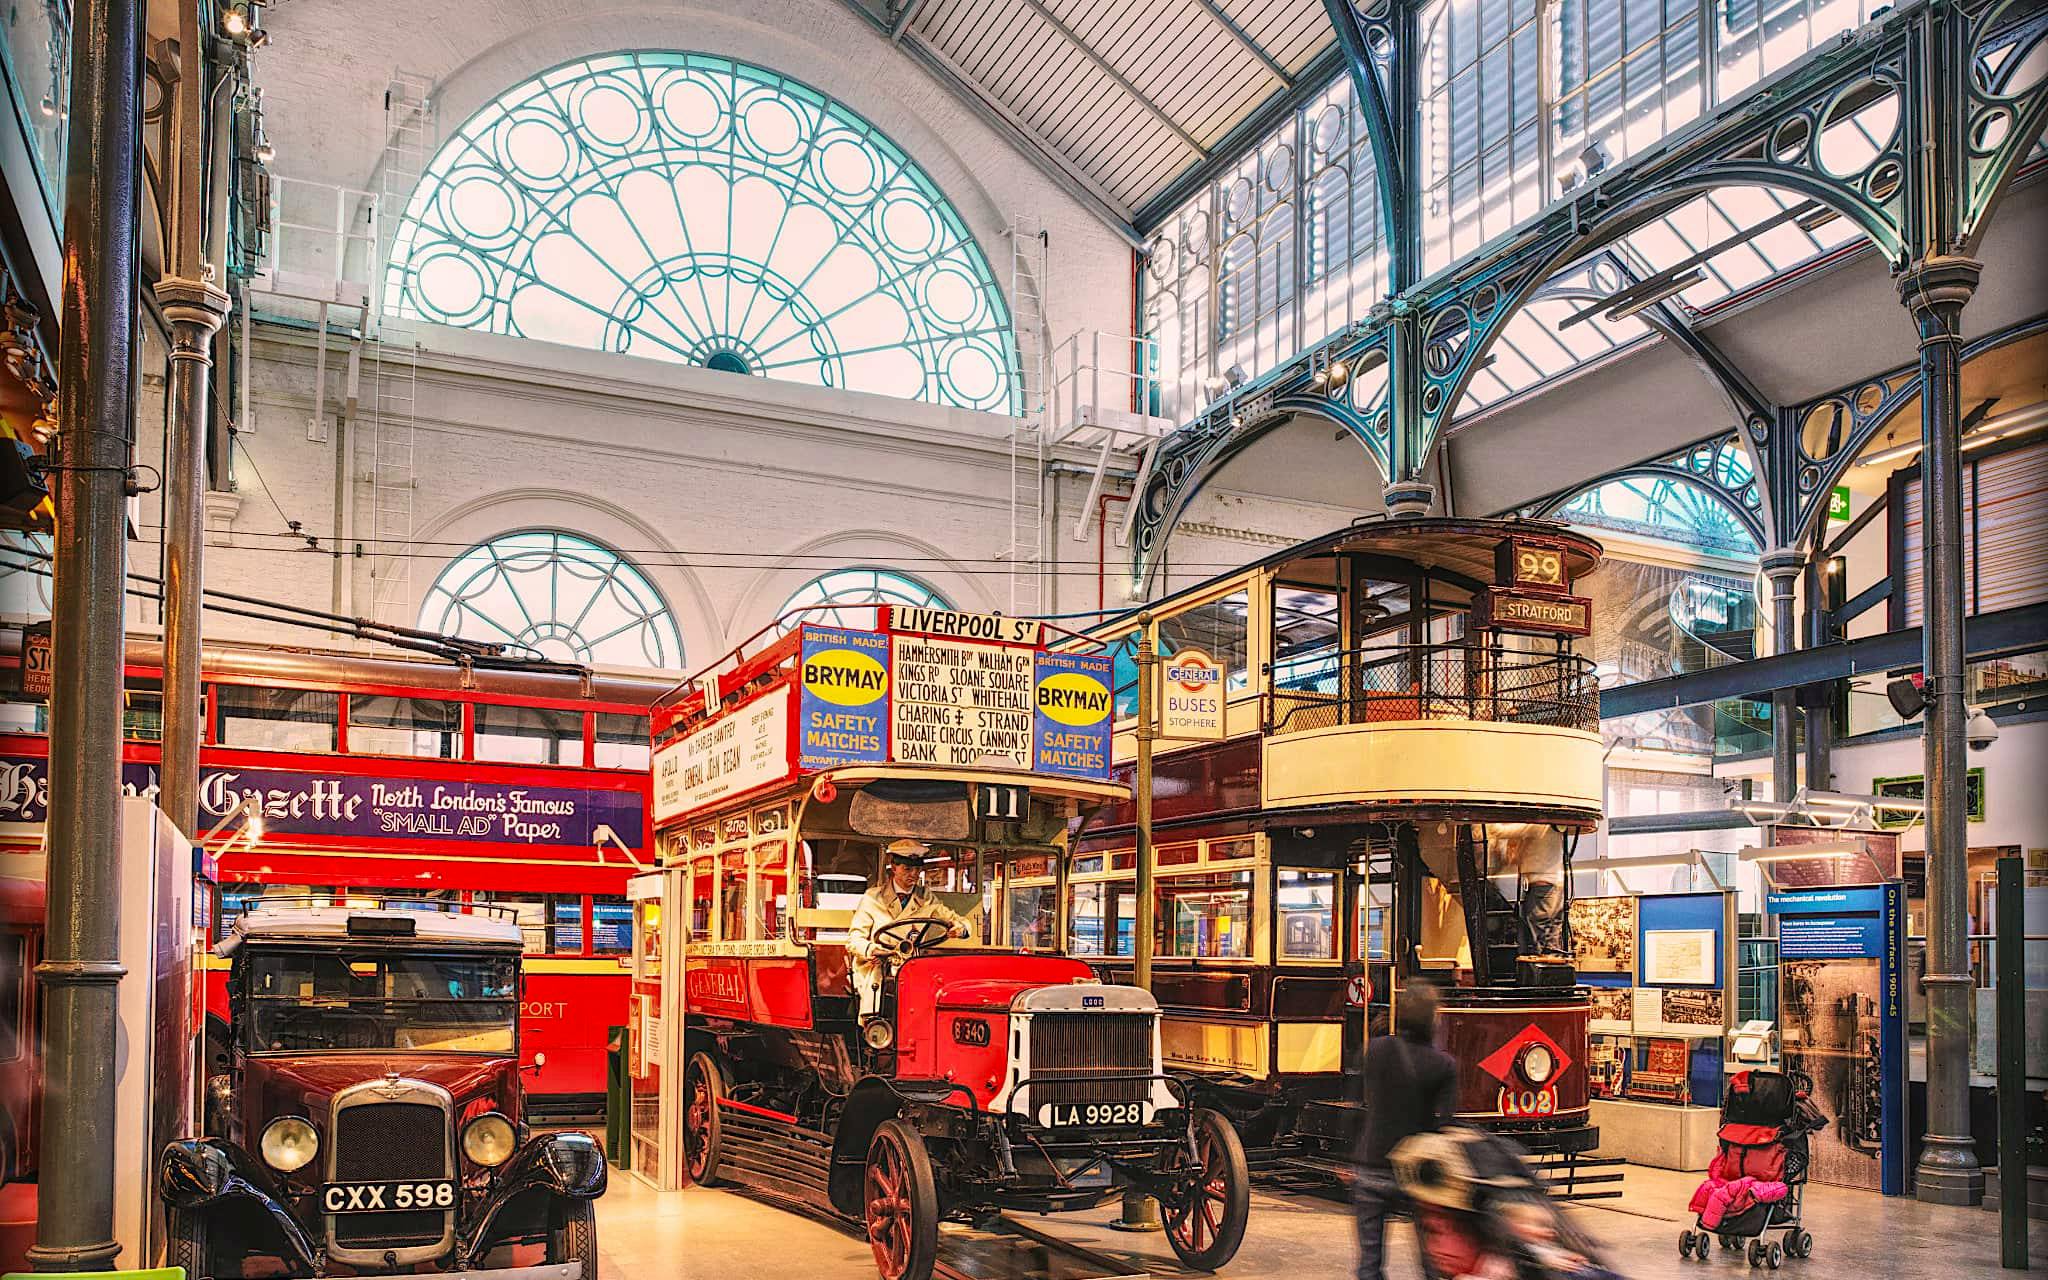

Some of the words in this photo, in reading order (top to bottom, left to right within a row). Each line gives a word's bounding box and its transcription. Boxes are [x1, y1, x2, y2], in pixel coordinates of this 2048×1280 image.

[1520, 553, 1560, 583] 99
[900, 607, 1004, 640] LIVERPOOL
[1013, 620, 1034, 641] ST
[1507, 603, 1572, 622] STRATFORD
[31, 636, 49, 645] CA
[805, 631, 847, 645] BRITISH
[28, 647, 51, 671] ST
[899, 643, 960, 667] HAMMERSMITH
[978, 651, 1013, 673] WALHAM
[1038, 656, 1075, 668] BRITISH
[1081, 662, 1110, 672] MADE
[804, 663, 884, 690] BRYMAY
[898, 662, 926, 682] KINGS
[929, 666, 940, 683] RD
[949, 668, 986, 688] SLOANE
[989, 671, 1029, 692] SQUARE
[706, 678, 718, 710] 11
[898, 682, 948, 703] VICTORIA
[952, 687, 963, 704] ST
[972, 688, 1030, 710] WHITEHALL
[1038, 687, 1108, 711] BRYMAY
[1169, 697, 1217, 713] BUSES
[811, 712, 877, 732] SAFETY
[898, 704, 950, 725] CHARING
[978, 711, 1029, 731] STRAND
[1169, 717, 1192, 727] STOP
[1193, 719, 1217, 728] HERE
[807, 730, 880, 751] MATCHES
[897, 723, 936, 743] LUDGATE
[940, 726, 973, 745] CIRCUS
[980, 729, 1018, 749] CANNON
[1020, 733, 1029, 750] ST
[1043, 732, 1102, 751] SAFETY
[902, 742, 937, 762] BANK
[1040, 750, 1105, 769] MATCHES
[685, 760, 703, 790] GENERAL
[706, 754, 720, 782] JOHN
[200, 772, 363, 822] Gazette
[371, 784, 424, 808] North
[430, 786, 506, 813] London's
[509, 791, 575, 815] Famous
[985, 787, 1019, 817] 11
[502, 814, 561, 843] Paper
[1888, 889, 1896, 905] On
[1888, 908, 1896, 927] the
[1888, 931, 1896, 969] surface
[690, 972, 744, 1004] GENERAL
[519, 1001, 568, 1019] PORT
[964, 1022, 985, 1042] 340
[1506, 1090, 1552, 1114] 102
[1054, 1105, 1080, 1126] LA
[1086, 1103, 1140, 1125] 9928
[325, 1185, 386, 1211] CXX
[394, 1183, 454, 1208] 598
